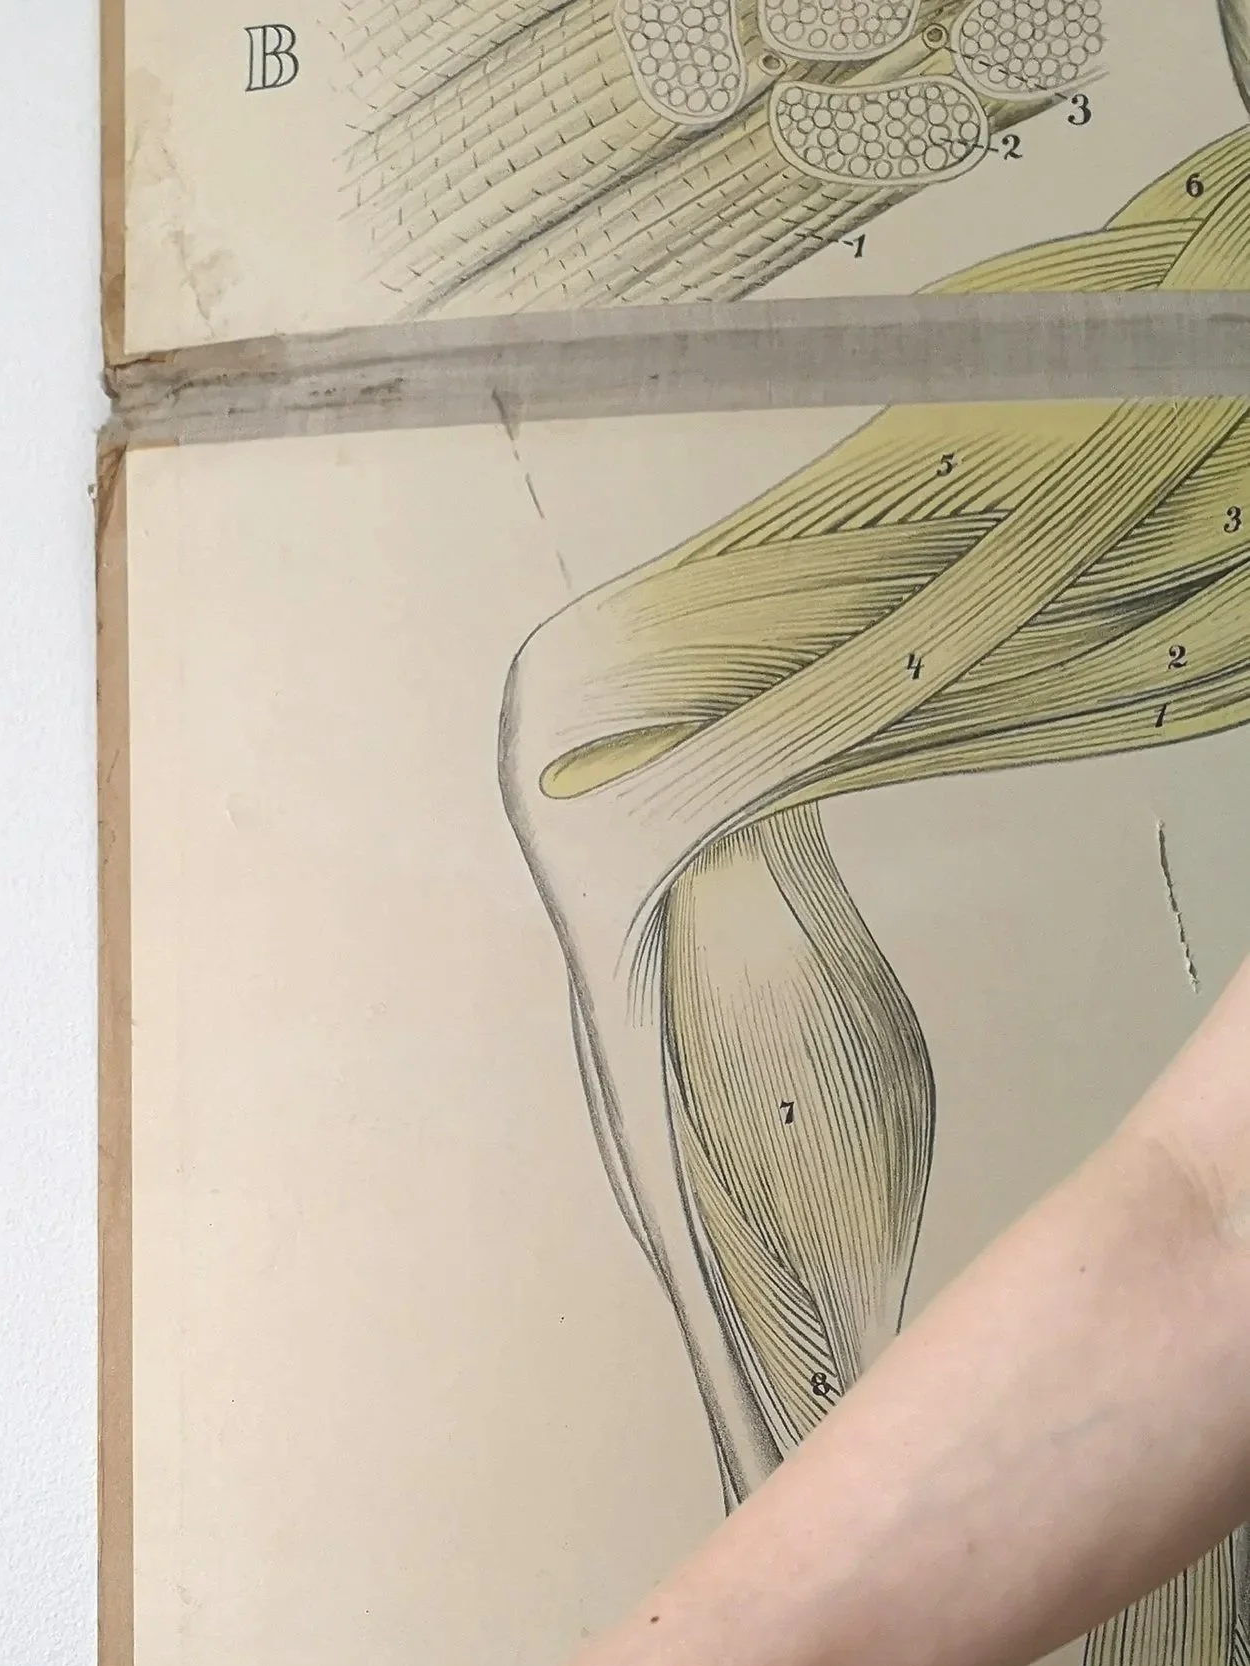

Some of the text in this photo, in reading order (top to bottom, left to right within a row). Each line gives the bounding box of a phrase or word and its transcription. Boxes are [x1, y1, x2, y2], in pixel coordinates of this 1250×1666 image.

[244, 23, 299, 92] B
[1067, 93, 1092, 126] 3
[1001, 134, 1023, 160] 2
[1185, 172, 1204, 198] 6
[852, 234, 866, 258] 1
[936, 452, 955, 477] 5
[1223, 506, 1242, 534] 3
[906, 653, 925, 680] 4
[1168, 645, 1188, 670] 2
[1155, 702, 1167, 728] 1
[779, 1099, 795, 1125] 7
[811, 1371, 830, 1396] 8
